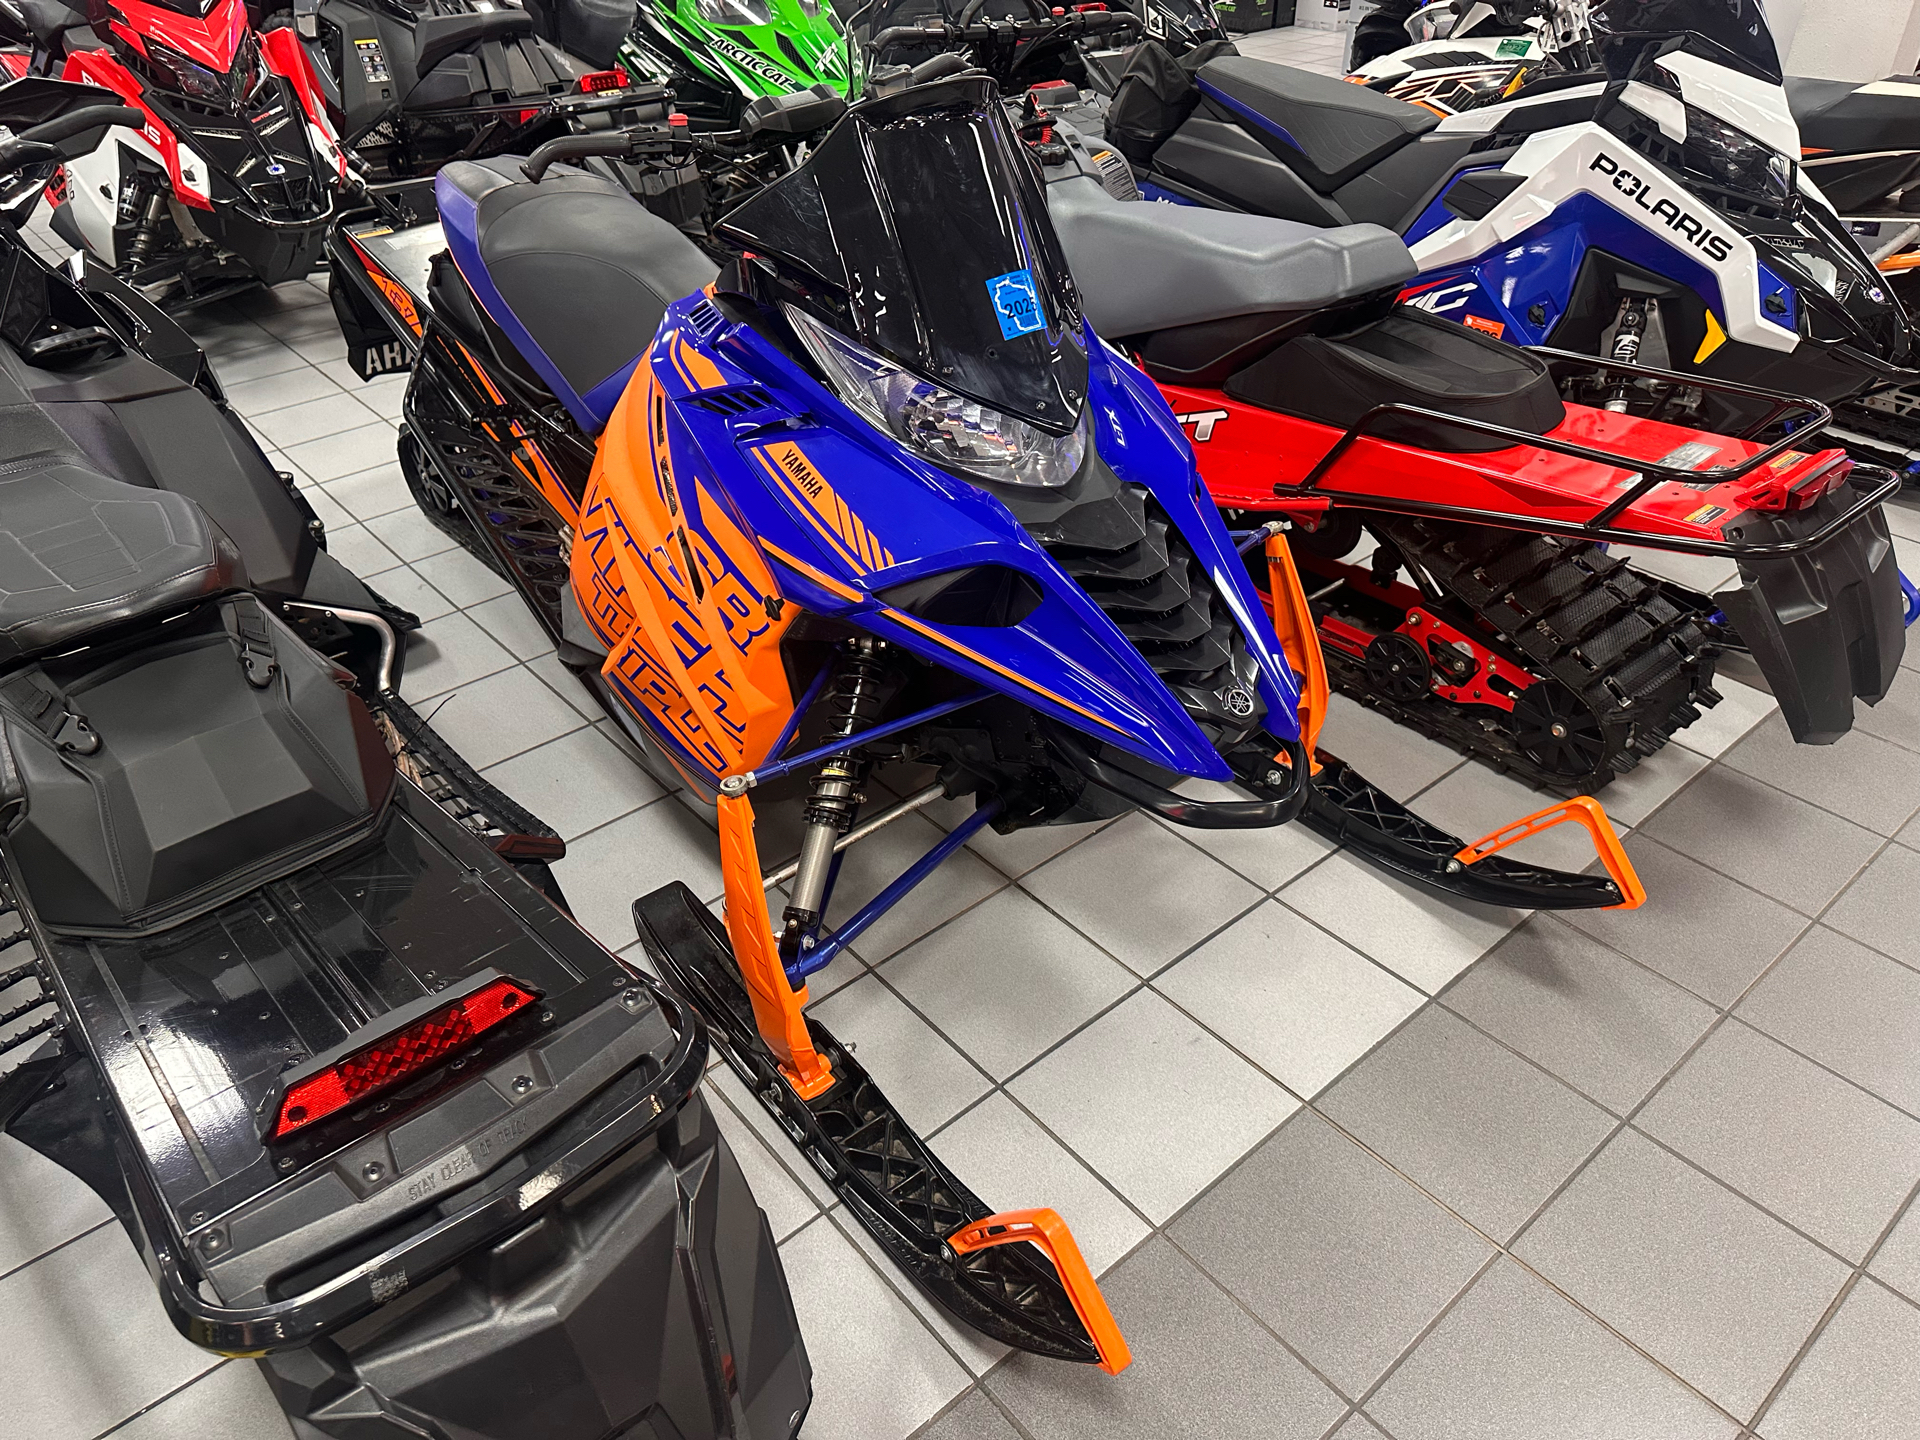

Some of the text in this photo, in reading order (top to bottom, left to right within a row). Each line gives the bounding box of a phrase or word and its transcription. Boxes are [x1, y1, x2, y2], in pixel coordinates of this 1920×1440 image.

[712, 37, 766, 73] ARCTIC
[761, 66, 796, 88] CAT
[1589, 152, 1734, 262] POLARIS
[781, 448, 824, 500] YAMAHA
[407, 1116, 530, 1201] STAY CLEAR OF TRACK
